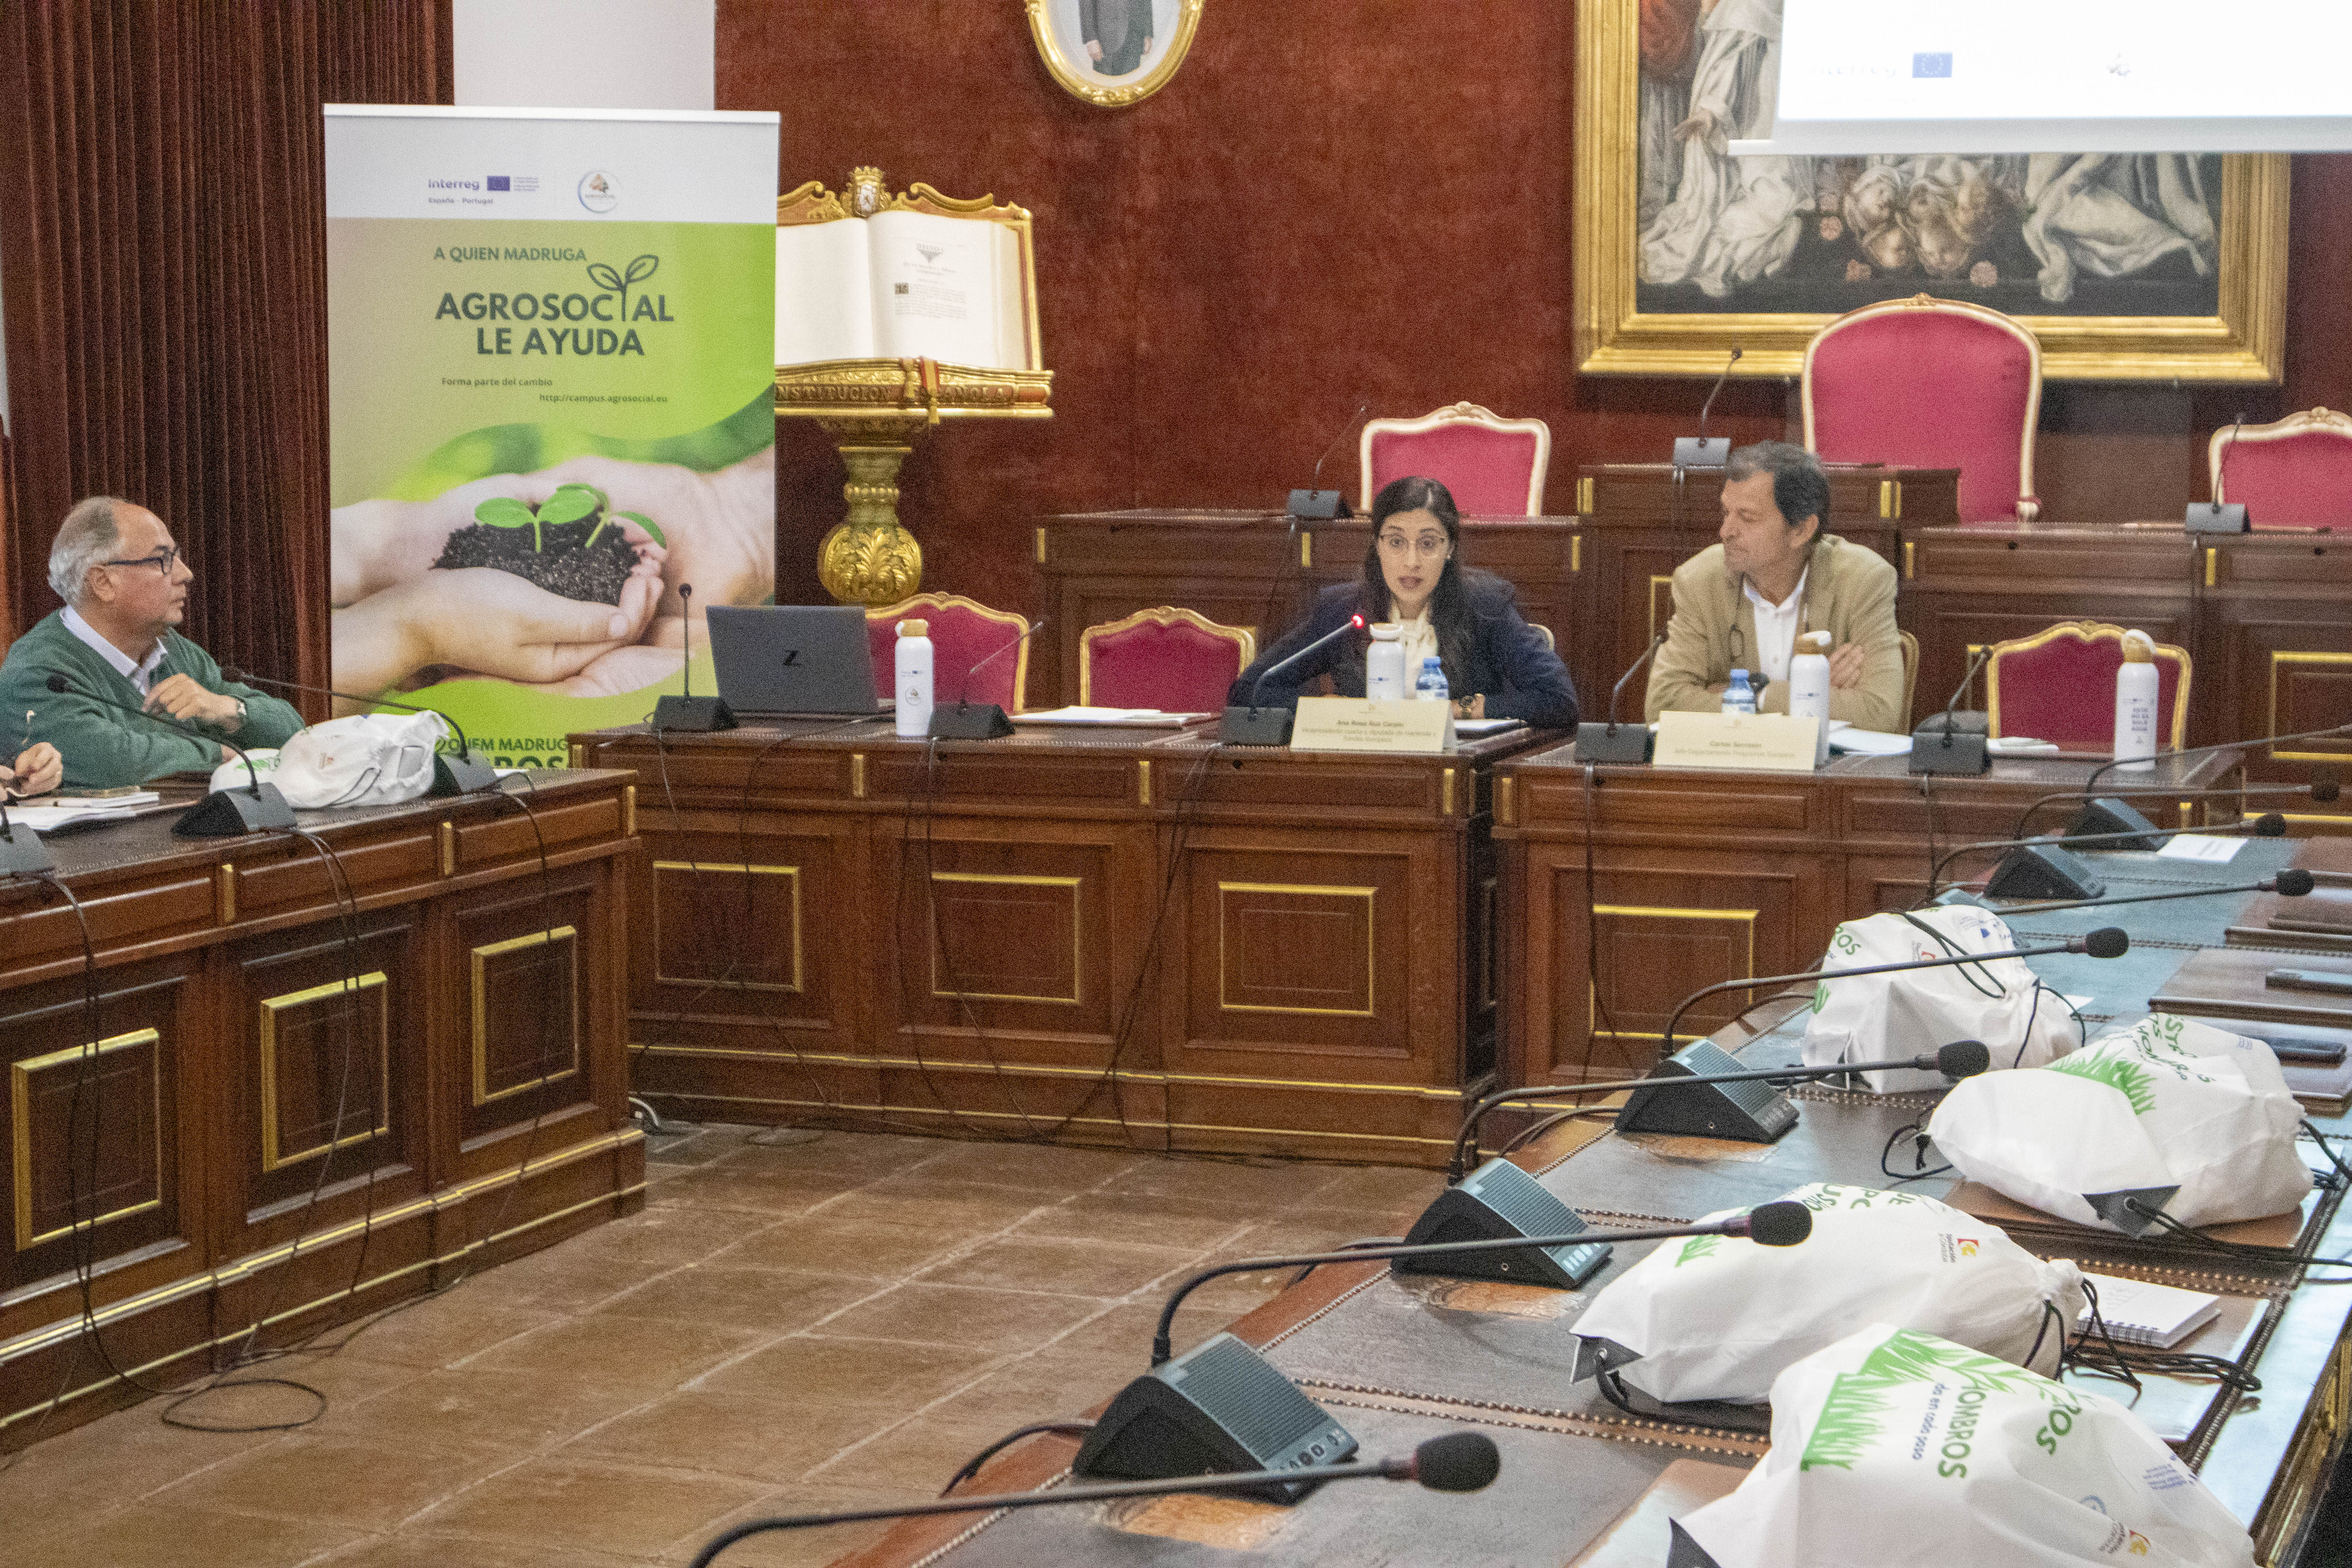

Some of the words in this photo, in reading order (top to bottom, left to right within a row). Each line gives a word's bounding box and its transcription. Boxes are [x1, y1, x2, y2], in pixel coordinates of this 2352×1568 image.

[434, 246, 445, 260] A
[449, 246, 499, 262] QUIEN
[504, 247, 586, 261] MADRUGA
[435, 290, 674, 322] AGROSOCIAL
[477, 328, 512, 355] LE
[522, 328, 645, 356] AYUDA
[441, 377, 472, 386] Forma
[474, 378, 500, 388] parte
[502, 377, 516, 386] del
[518, 377, 553, 387] cambio
[539, 394, 668, 405] http://campus.agrosocial.eu
